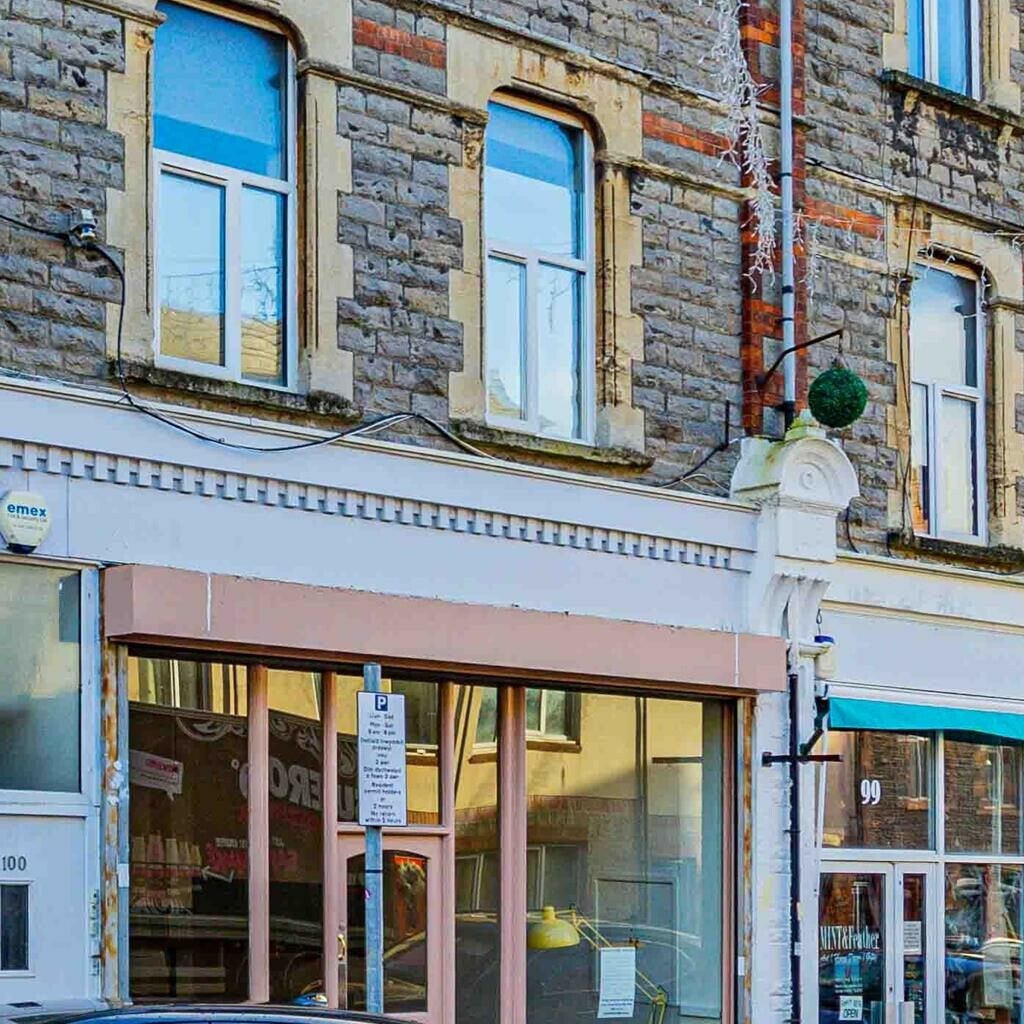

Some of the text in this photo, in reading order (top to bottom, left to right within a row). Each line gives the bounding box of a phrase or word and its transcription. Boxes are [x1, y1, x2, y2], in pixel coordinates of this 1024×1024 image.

[7, 503, 47, 517] emex
[377, 696, 387, 710] P
[860, 779, 881, 805] 99
[2, 855, 27, 871] 100
